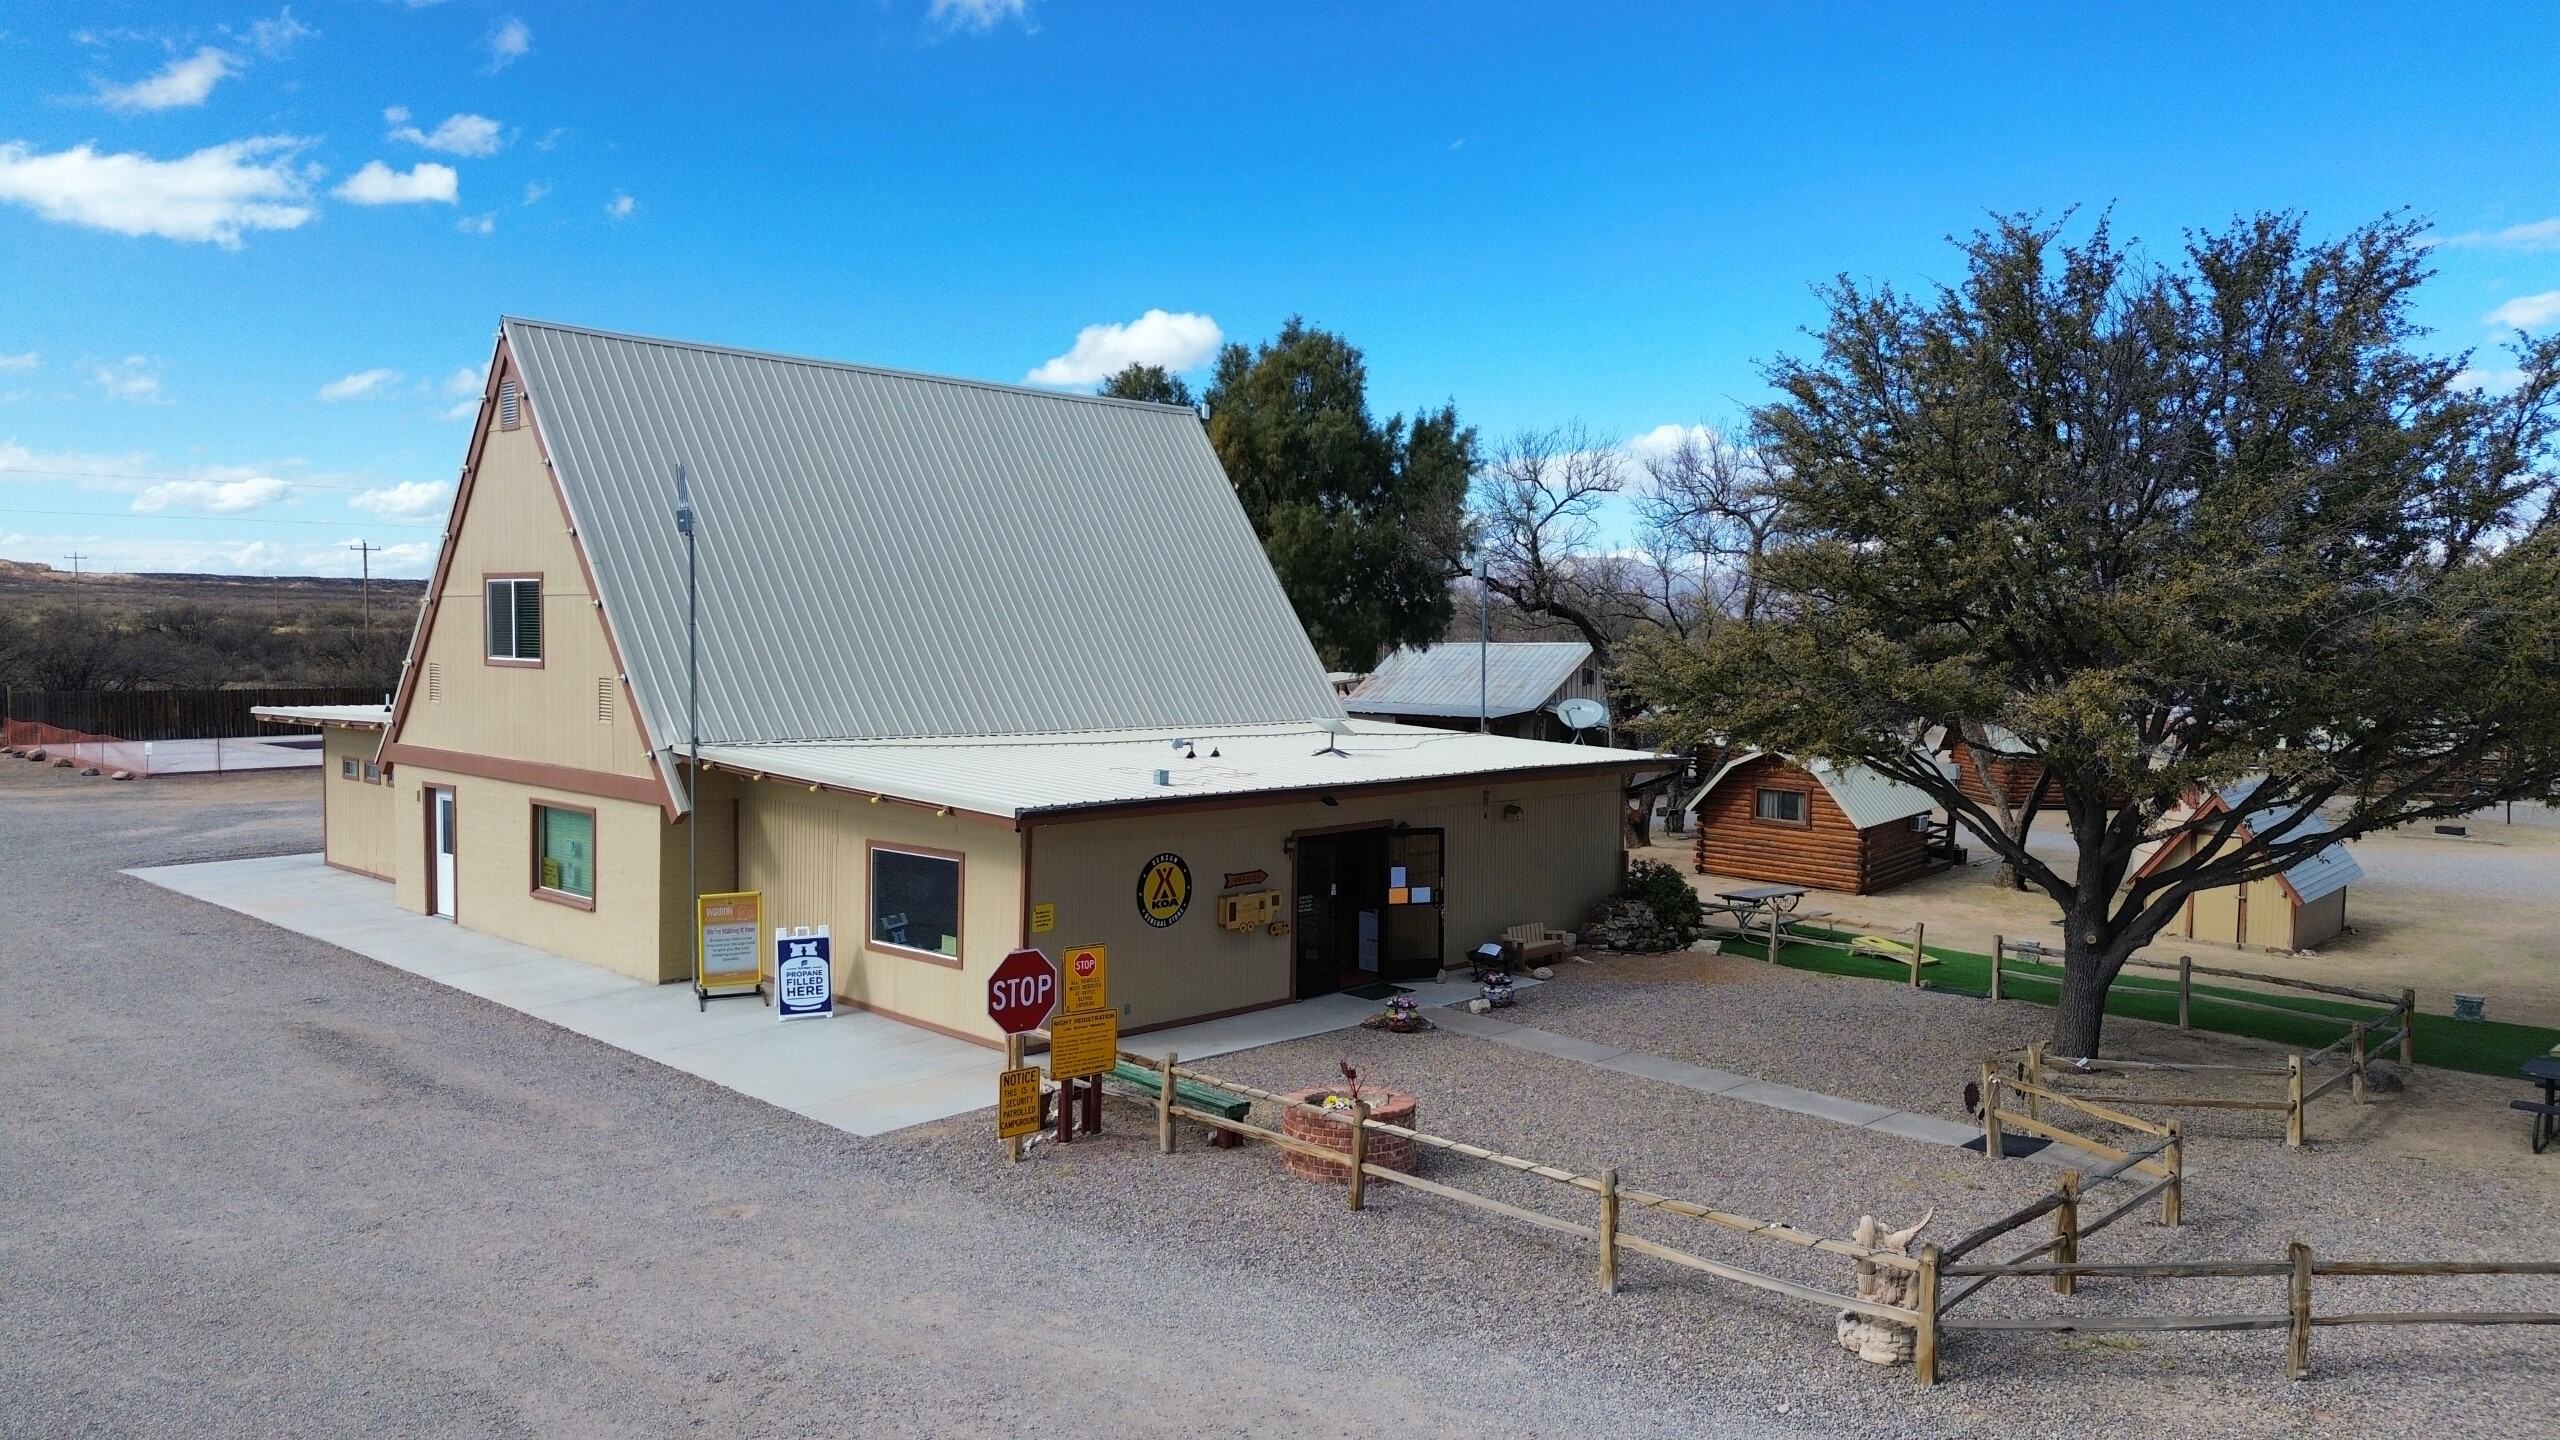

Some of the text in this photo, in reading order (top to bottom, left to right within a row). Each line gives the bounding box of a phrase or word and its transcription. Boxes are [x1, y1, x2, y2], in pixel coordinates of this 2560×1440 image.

[1152, 898, 1179, 910] KOA
[706, 907, 733, 917] PARDON
[1168, 907, 1185, 924] STORE
[1076, 959, 1095, 970] STOP
[786, 969, 823, 978] PROPANE
[786, 976, 823, 986] FILLED
[787, 985, 824, 997] HERE
[992, 974, 1052, 1011] STOP
[1054, 1019, 1072, 1027] NIGHT
[1074, 1014, 1115, 1024] REGISTRATION
[1003, 1070, 1036, 1087] NOTICE
[1004, 1088, 1017, 1097] THIS
[1031, 1085, 1036, 1093] A
[1006, 1096, 1034, 1108] SECURITY
[1003, 1106, 1036, 1119] PATROLLED
[1001, 1116, 1038, 1130] CAMPGROUND
